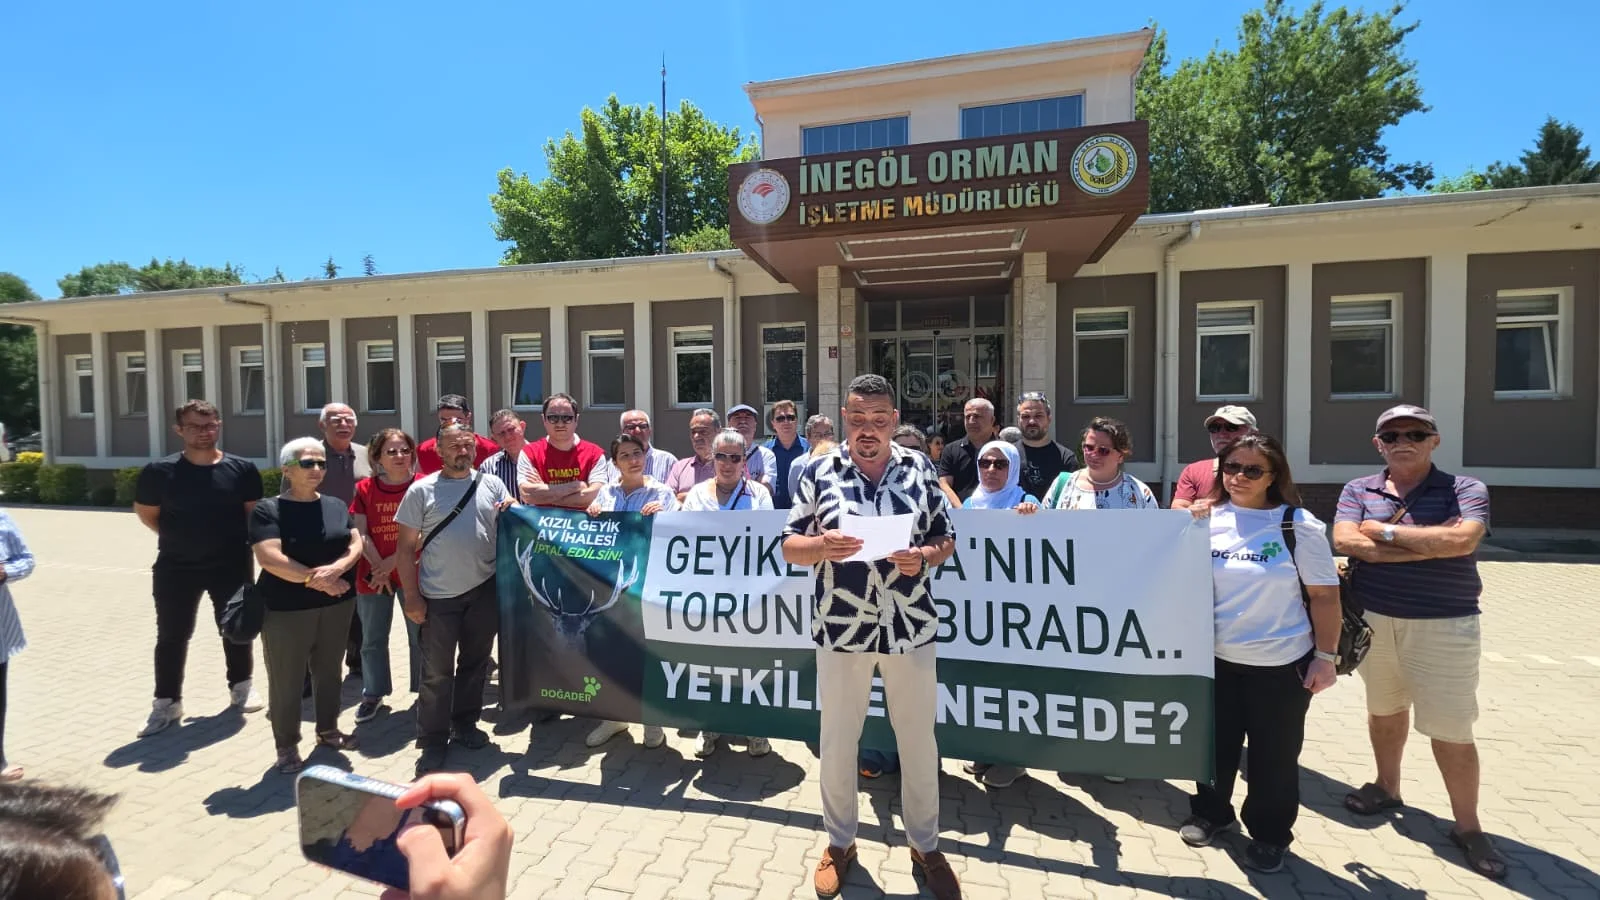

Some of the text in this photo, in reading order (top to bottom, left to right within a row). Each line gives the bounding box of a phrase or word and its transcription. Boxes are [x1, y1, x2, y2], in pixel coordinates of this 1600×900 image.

[799, 149, 918, 195] İNEGÖL
[927, 139, 1058, 183] ORMAN
[799, 179, 1060, 228] İŞLETME MÜDÜRLÜĞÜ
[537, 528, 617, 547] AV İHALESİ
[538, 516, 621, 533] KIZIL GEYİK
[533, 541, 623, 561] İPTAL EDİLSİN!
[934, 537, 1075, 585] A'NIN
[1211, 548, 1269, 563] OĞADER
[659, 590, 816, 635] TORUN
[540, 688, 592, 703] DOĞADER
[936, 682, 1190, 745] NEREDE?
